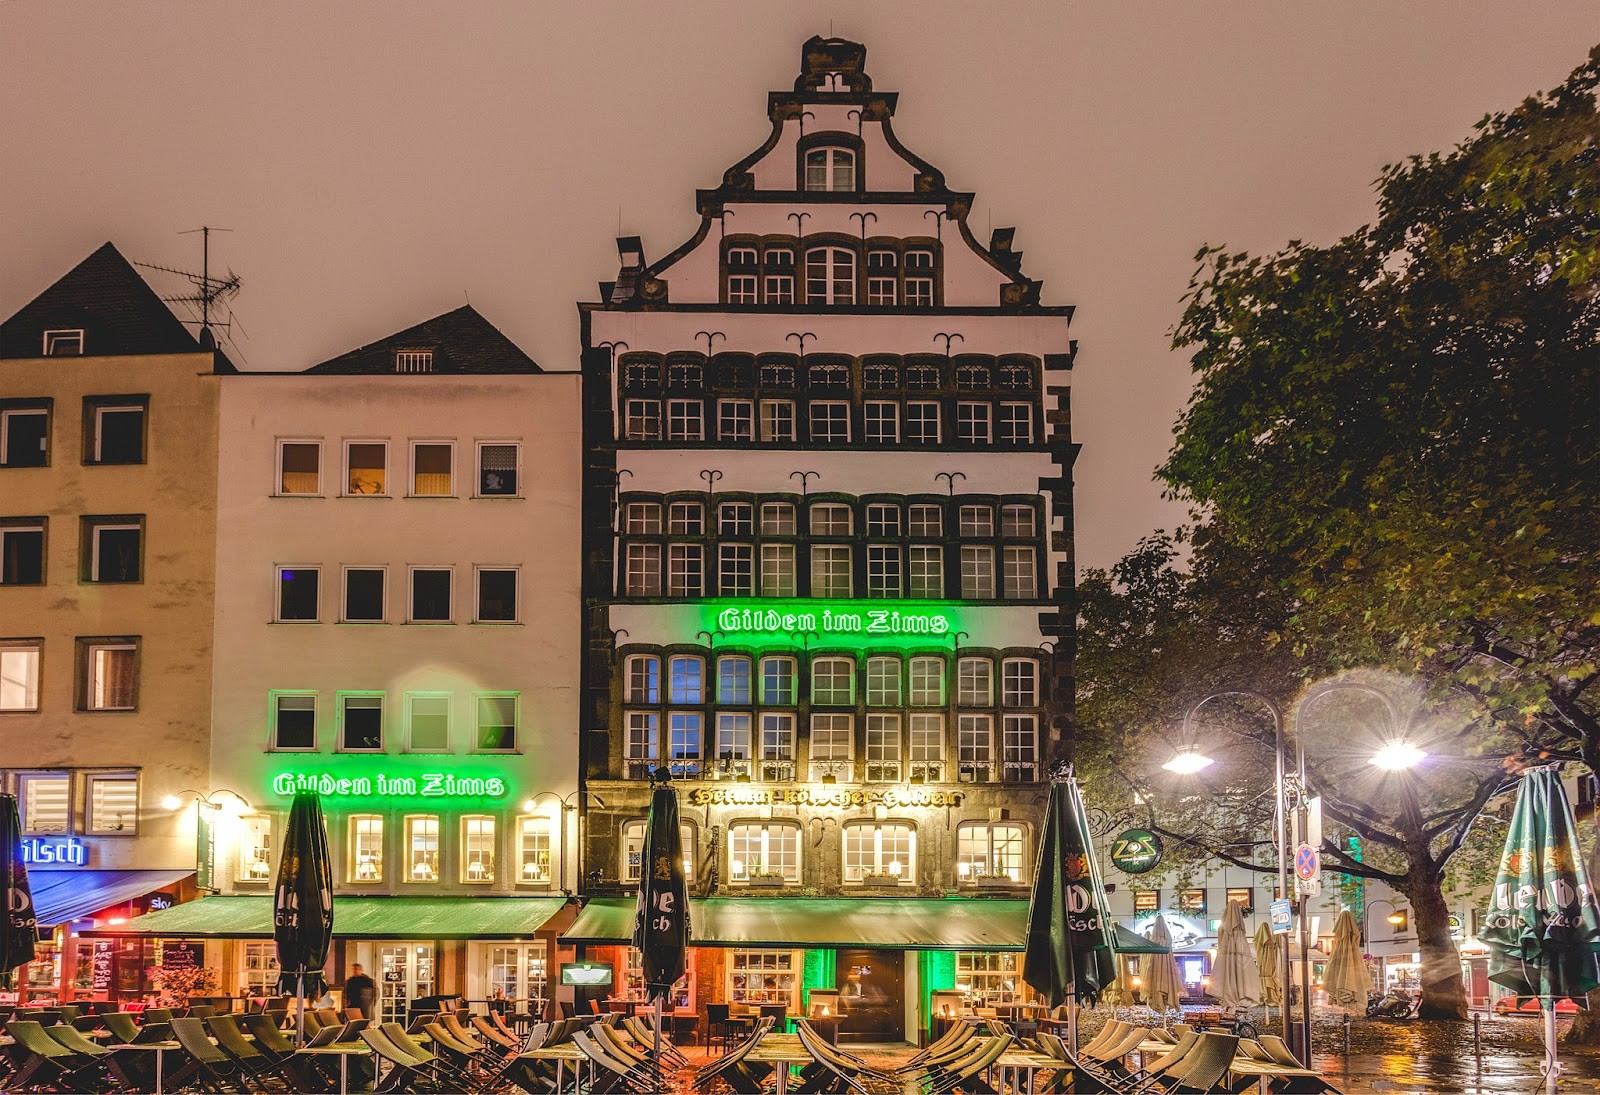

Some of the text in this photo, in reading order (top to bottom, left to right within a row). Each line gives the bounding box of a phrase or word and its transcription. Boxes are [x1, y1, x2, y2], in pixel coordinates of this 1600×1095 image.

[718, 607, 949, 634] Gilden im Zims
[273, 772, 505, 797] Gilden im Zims
